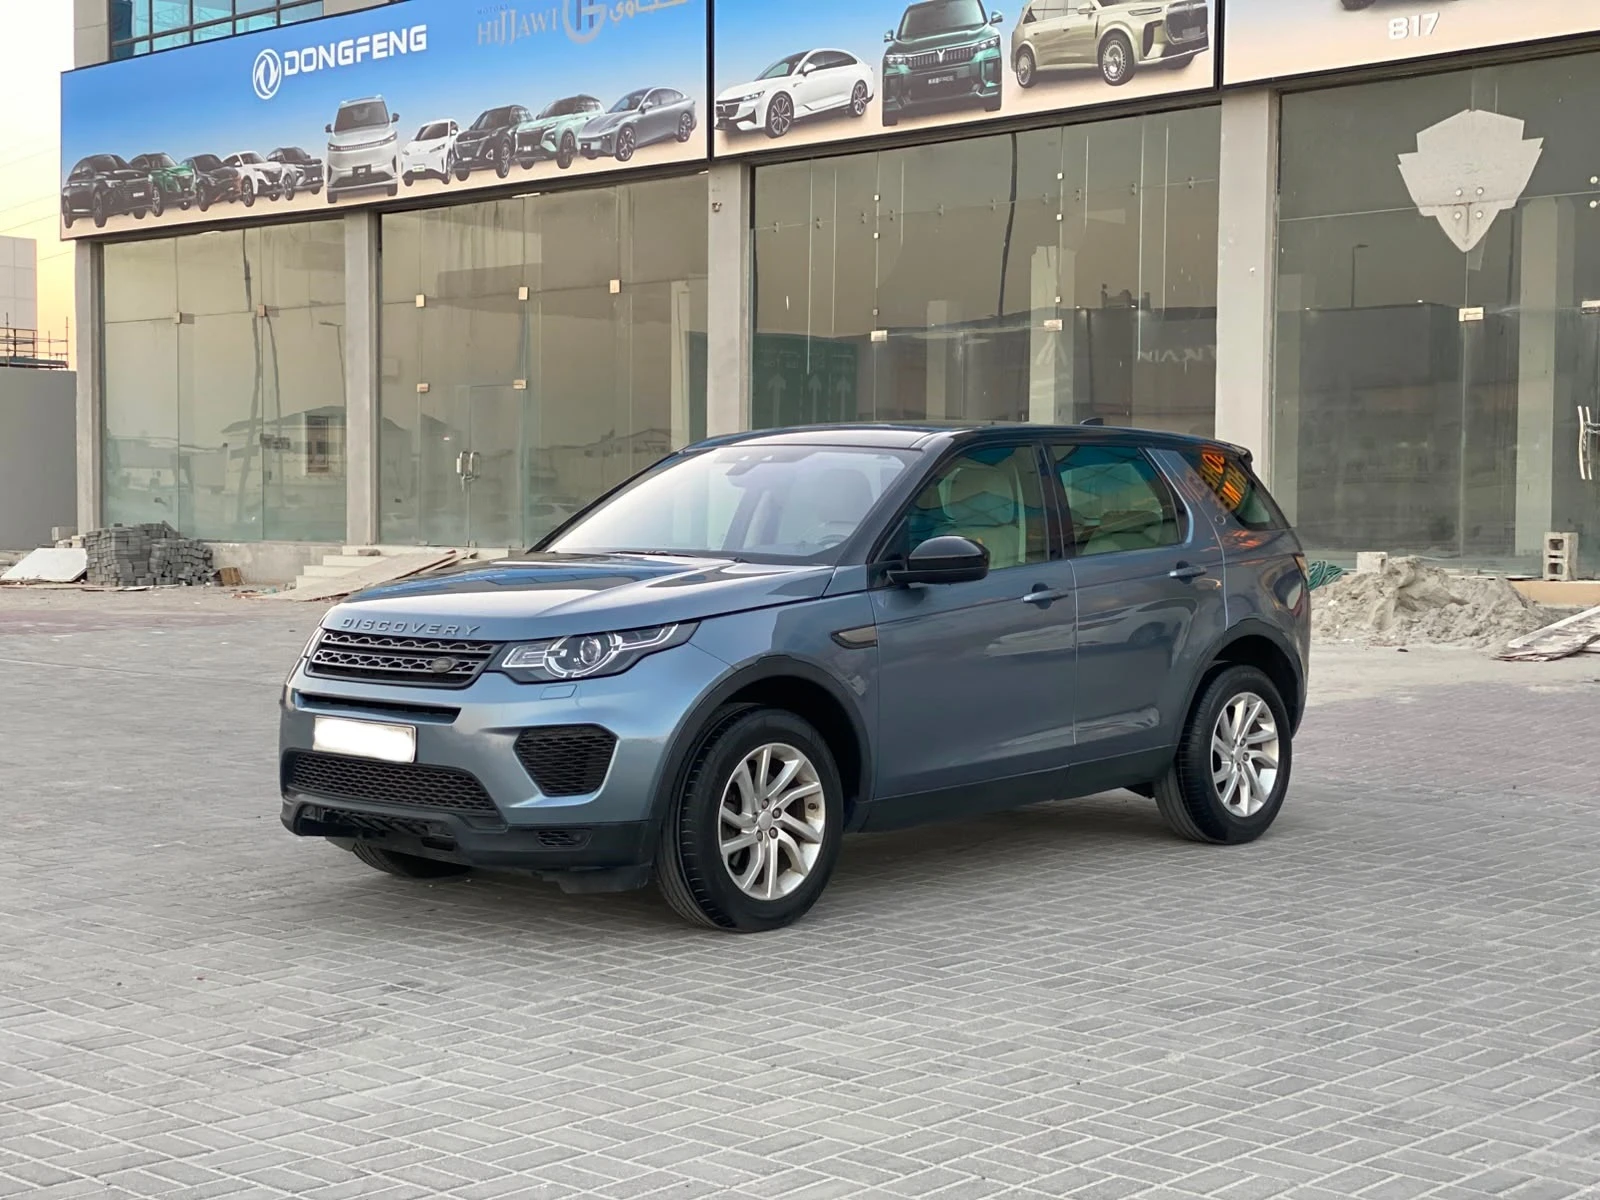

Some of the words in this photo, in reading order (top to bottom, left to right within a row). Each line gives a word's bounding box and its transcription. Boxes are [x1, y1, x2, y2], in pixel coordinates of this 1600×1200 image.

[1388, 12, 1440, 40] 817
[284, 24, 427, 77] DONGFENG
[341, 617, 480, 637] DISCOVERY
